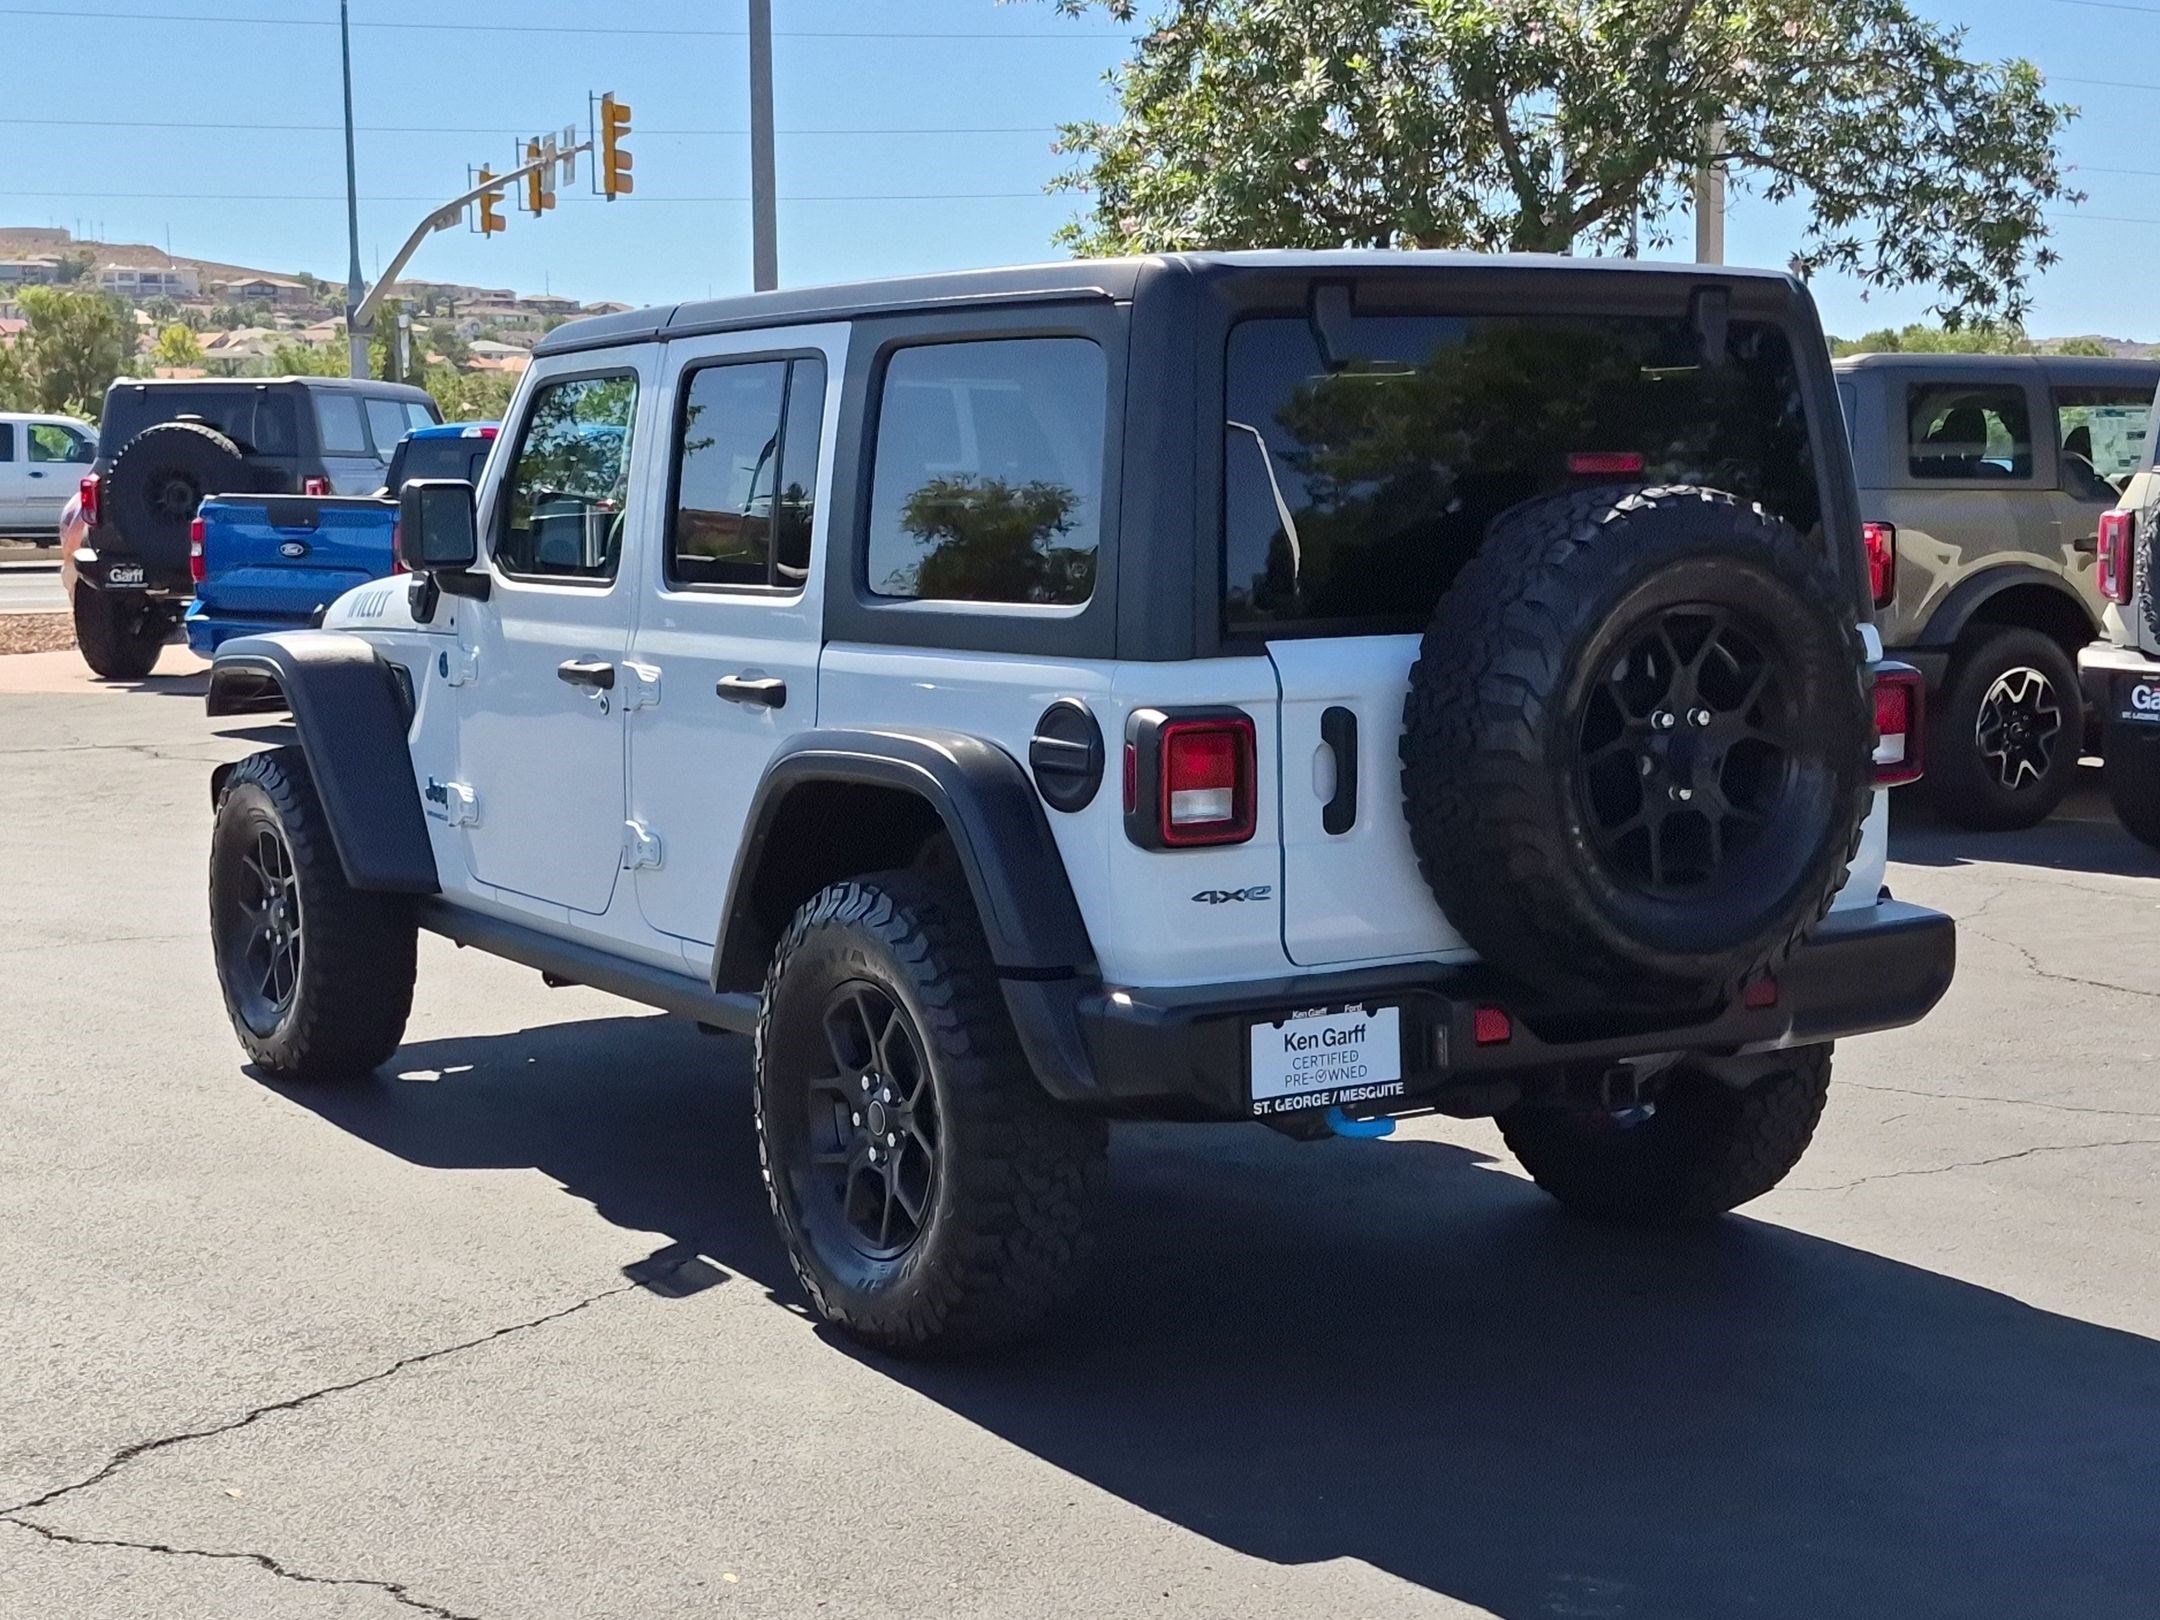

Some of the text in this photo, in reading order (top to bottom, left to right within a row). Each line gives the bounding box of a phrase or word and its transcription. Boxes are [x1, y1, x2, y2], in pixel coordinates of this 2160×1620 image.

[1284, 1023, 1367, 1053] Ken Garff
[1292, 1049, 1359, 1071] CERTIFIED
[1284, 1064, 1368, 1089] PRE-OWNED
[1253, 1100, 1272, 1116] ST.
[1274, 1092, 1330, 1112] GEORGE
[1340, 1081, 1405, 1103] MESQUITE
